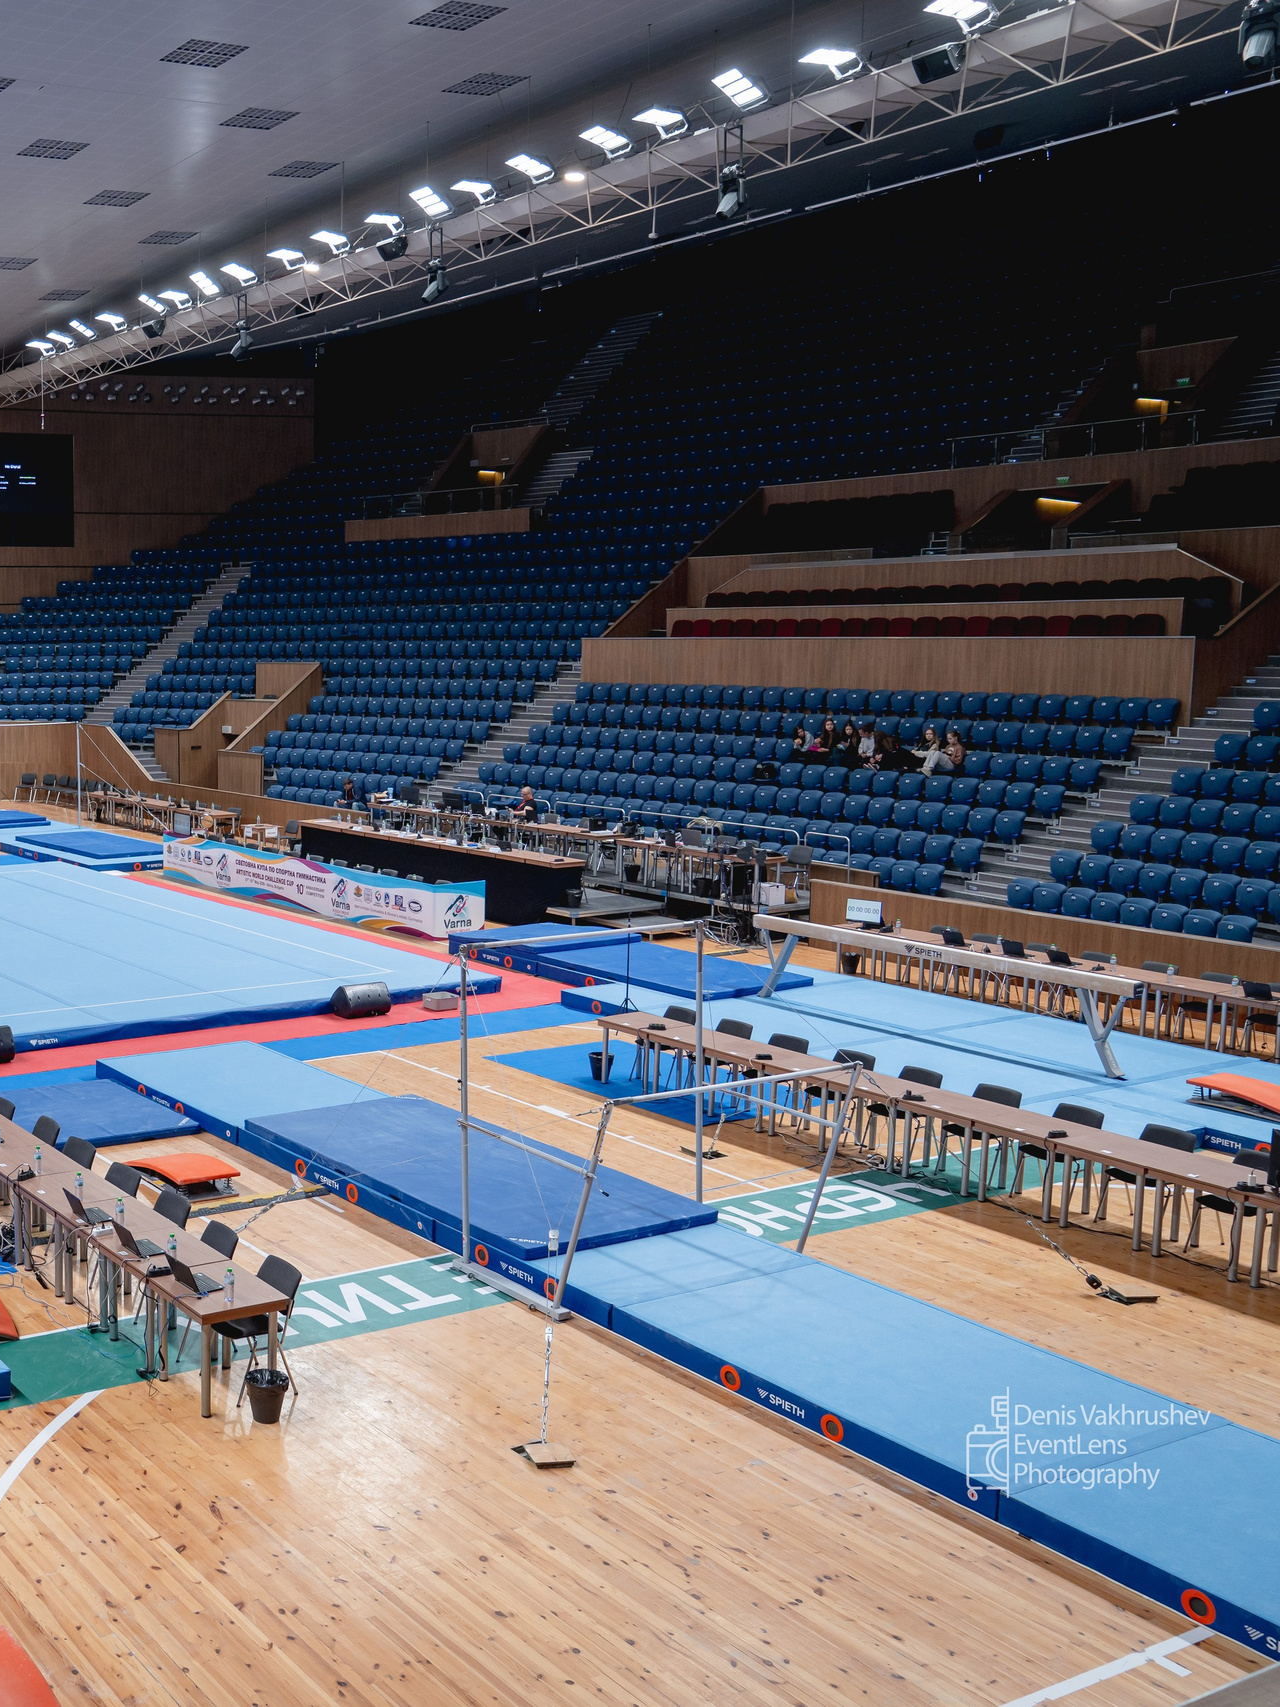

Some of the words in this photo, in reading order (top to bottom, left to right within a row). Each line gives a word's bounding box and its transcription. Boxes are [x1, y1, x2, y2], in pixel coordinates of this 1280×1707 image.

[216, 871, 231, 882] Varna
[235, 859, 256, 869] СВЕТОВНА
[276, 867, 295, 878] СПОРТНА
[296, 872, 326, 884] ГИМНАСТИКА
[236, 869, 251, 877] ARTISTIC
[252, 872, 265, 880] WORLD
[265, 875, 286, 886] CHALLENGE
[331, 898, 351, 911] Varna
[444, 919, 472, 929] Varna
[914, 947, 942, 959] SPIETH
[37, 1038, 58, 1046] SPIETH
[1210, 1136, 1242, 1150] SPIETH
[320, 1175, 339, 1190] SPIETH
[508, 1265, 534, 1284] SPIETH
[769, 1393, 805, 1419] SPIETH
